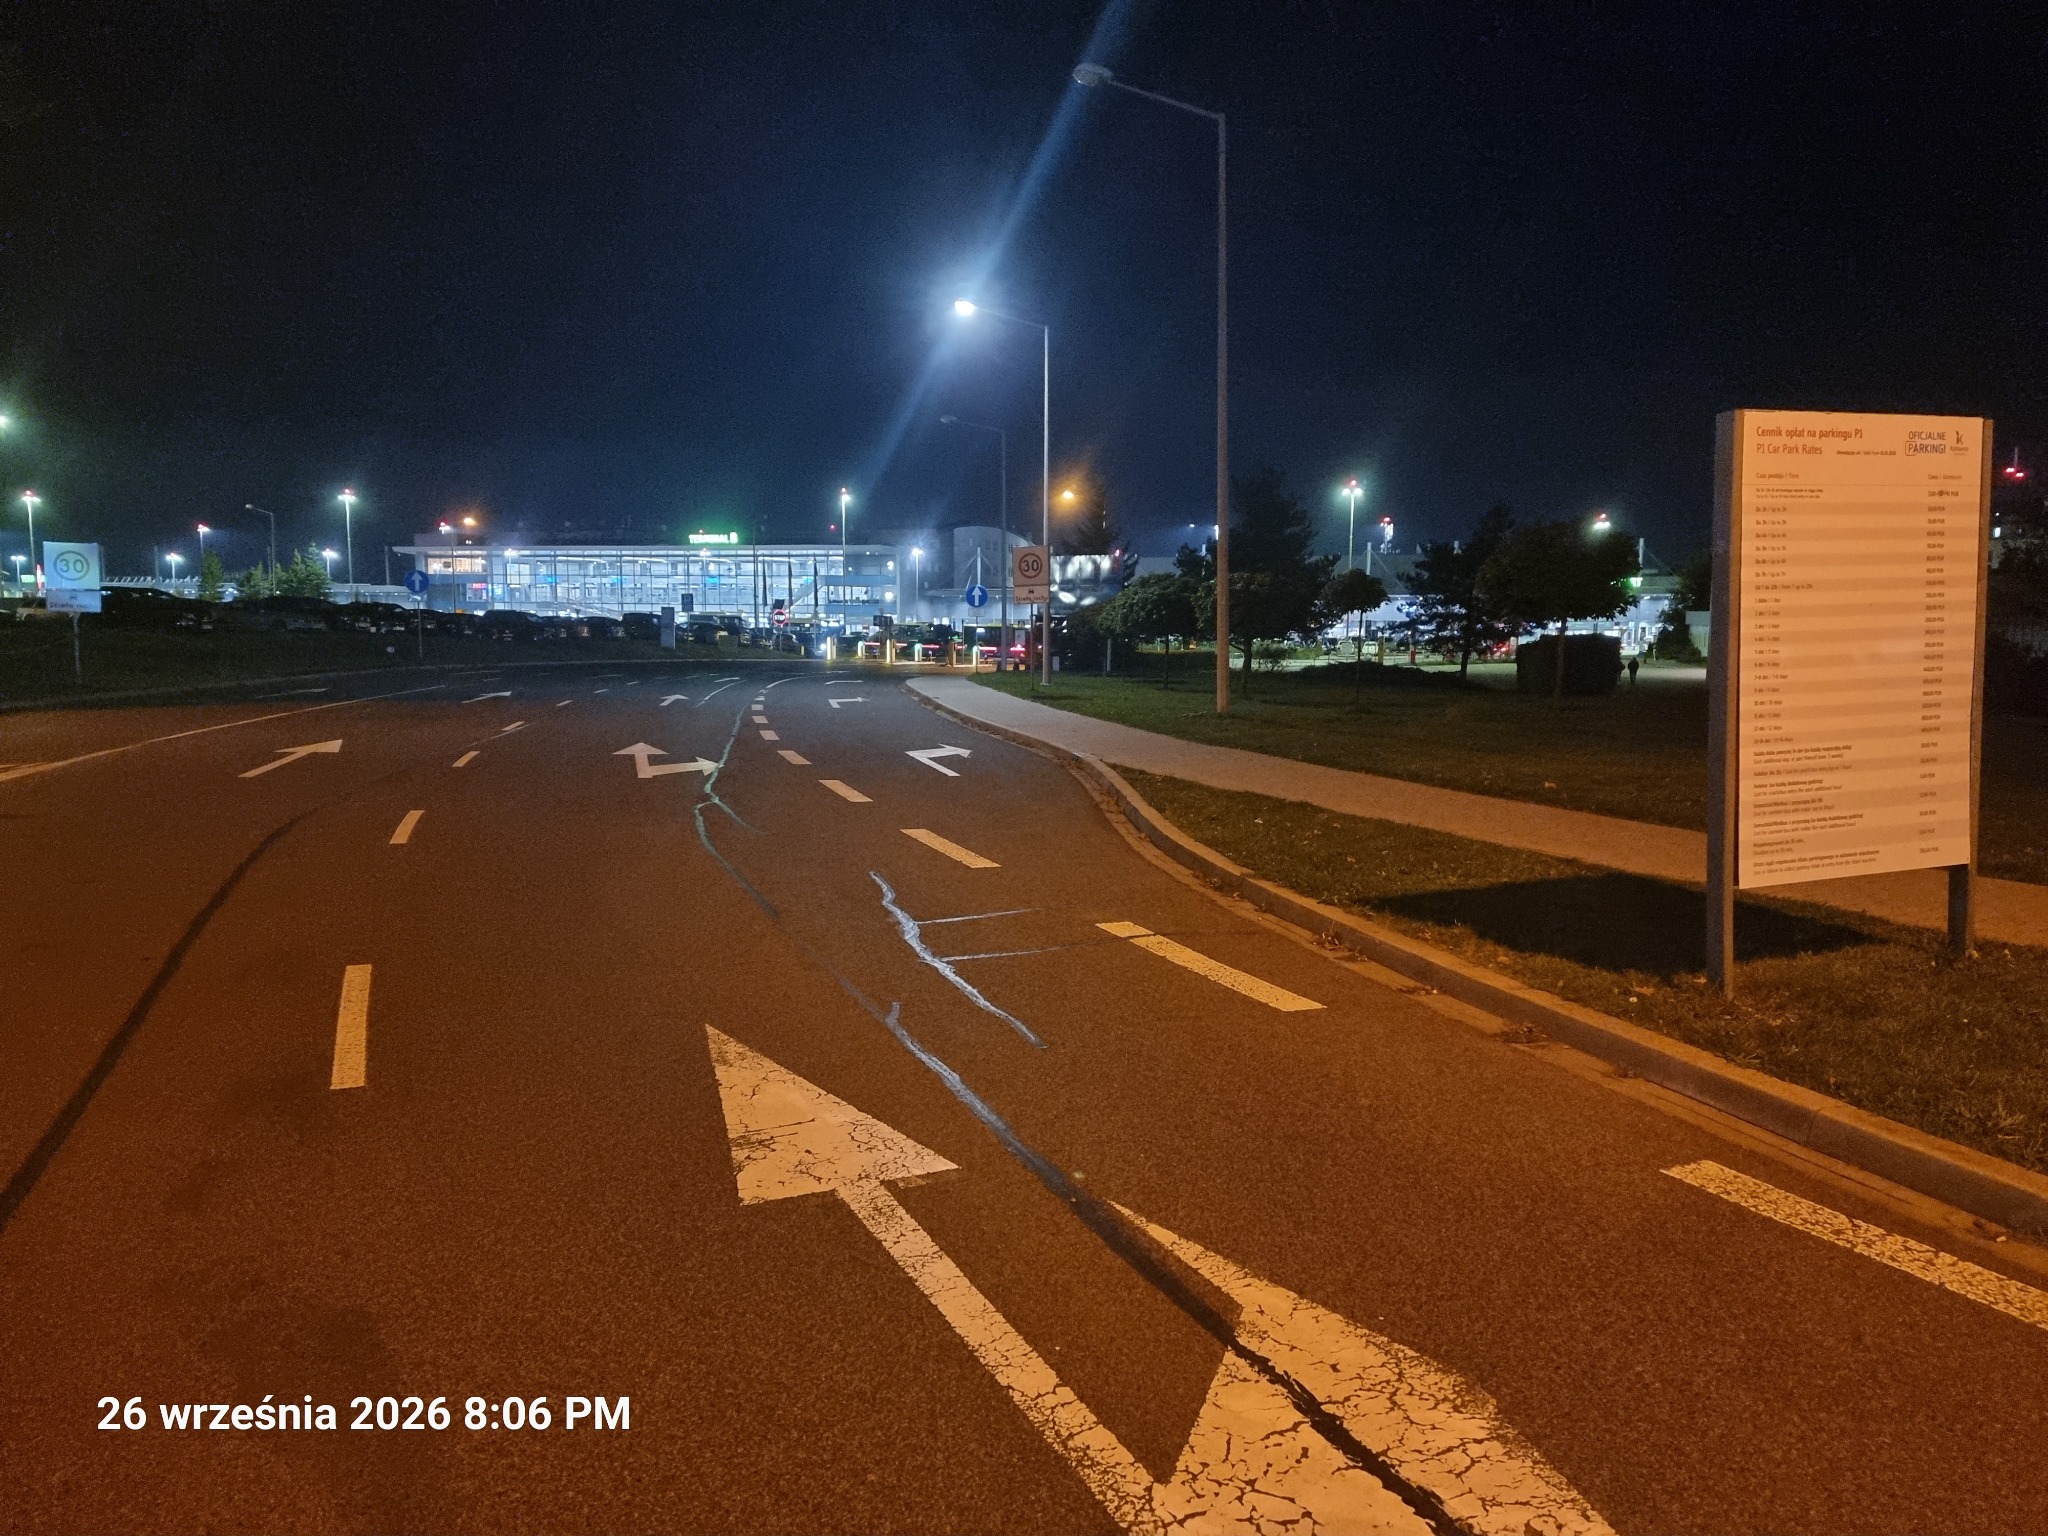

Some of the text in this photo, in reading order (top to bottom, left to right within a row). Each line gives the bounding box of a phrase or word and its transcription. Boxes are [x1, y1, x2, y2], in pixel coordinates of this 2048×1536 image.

[1756, 426, 1863, 441] Cennik opłat na parkingu P1
[1908, 431, 1946, 440] OFICJALNE
[1756, 444, 1823, 455] P1 Car Park Rates
[1908, 443, 1946, 454] PARKINGI
[59, 558, 84, 573] 30
[1023, 559, 1039, 572] 30
